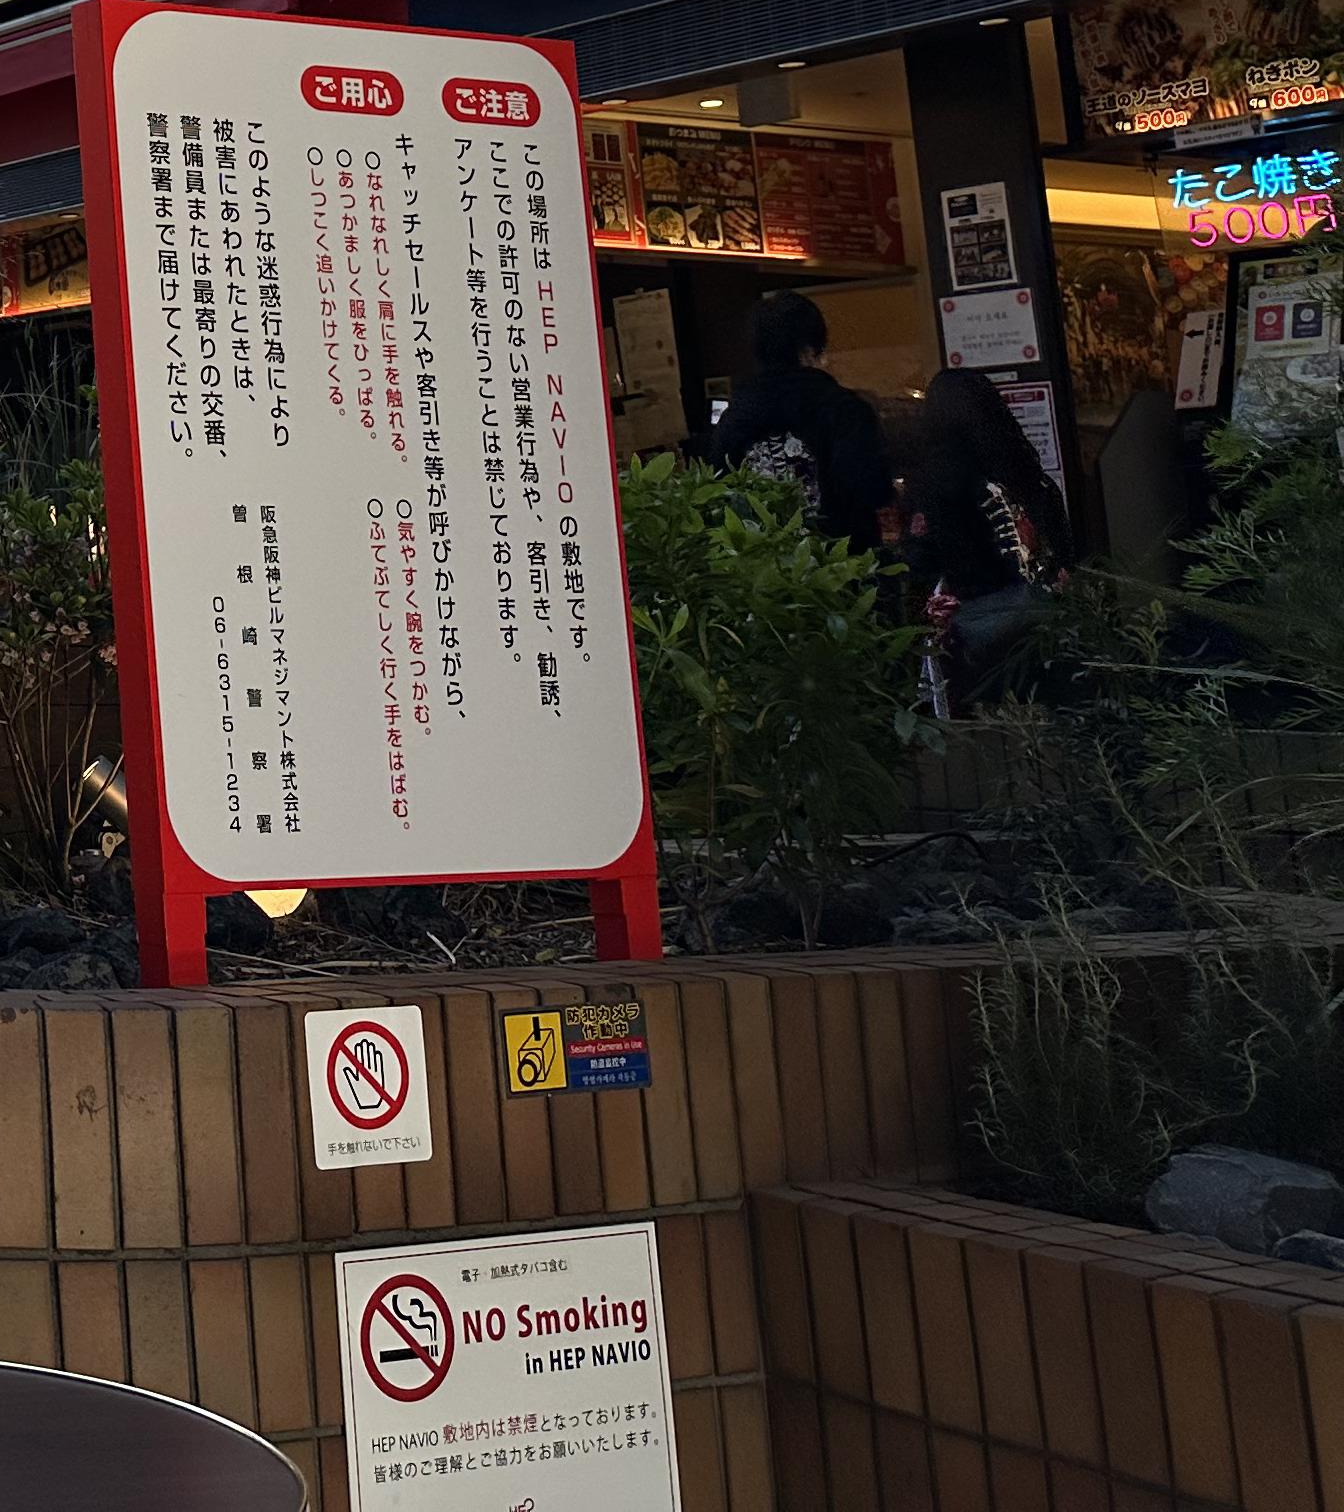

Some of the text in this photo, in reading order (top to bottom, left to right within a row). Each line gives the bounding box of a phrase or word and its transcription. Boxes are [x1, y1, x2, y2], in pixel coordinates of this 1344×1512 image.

[313, 74, 393, 110] ご用心
[1245, 57, 1320, 87] ねぎポン
[455, 87, 531, 121] ご注意
[1085, 76, 1210, 117] 王道のソースマヨ
[1270, 85, 1330, 111] 600円
[1133, 108, 1188, 133] 500円
[1168, 148, 1343, 208] たこ焼き
[1188, 193, 1337, 248] 500円
[212, 117, 257, 403] 被害にあわれたときは、
[146, 111, 194, 458] 警察署まで届けてください。
[179, 114, 228, 458] 警備員または最寄りの交番、
[247, 120, 291, 448] このような迷惑行為により
[454, 138, 521, 663] アンケート等を行うことは禁じております。
[523, 143, 591, 663] この場所は HEP NAVIO の敷地です。
[395, 133, 466, 719] キャッチセールスや客引き等が呼びかけながら、
[212, 595, 242, 834] 06-6315-1234
[565, 1003, 640, 1026] 防犯カメラ
[582, 1020, 629, 1040] 作動中
[570, 1044, 596, 1055] Security
[597, 1042, 624, 1052] Cameras
[327, 1137, 421, 1156] 手を触れないで下さい
[462, 1294, 648, 1345] NO Smoking
[525, 1338, 652, 1375] in HEP NAVIO
[371, 1435, 396, 1455] HEP
[398, 1429, 439, 1450] NAVIO
[373, 1428, 660, 1485] 皆様のご理解とご協力をお願いいたします。
